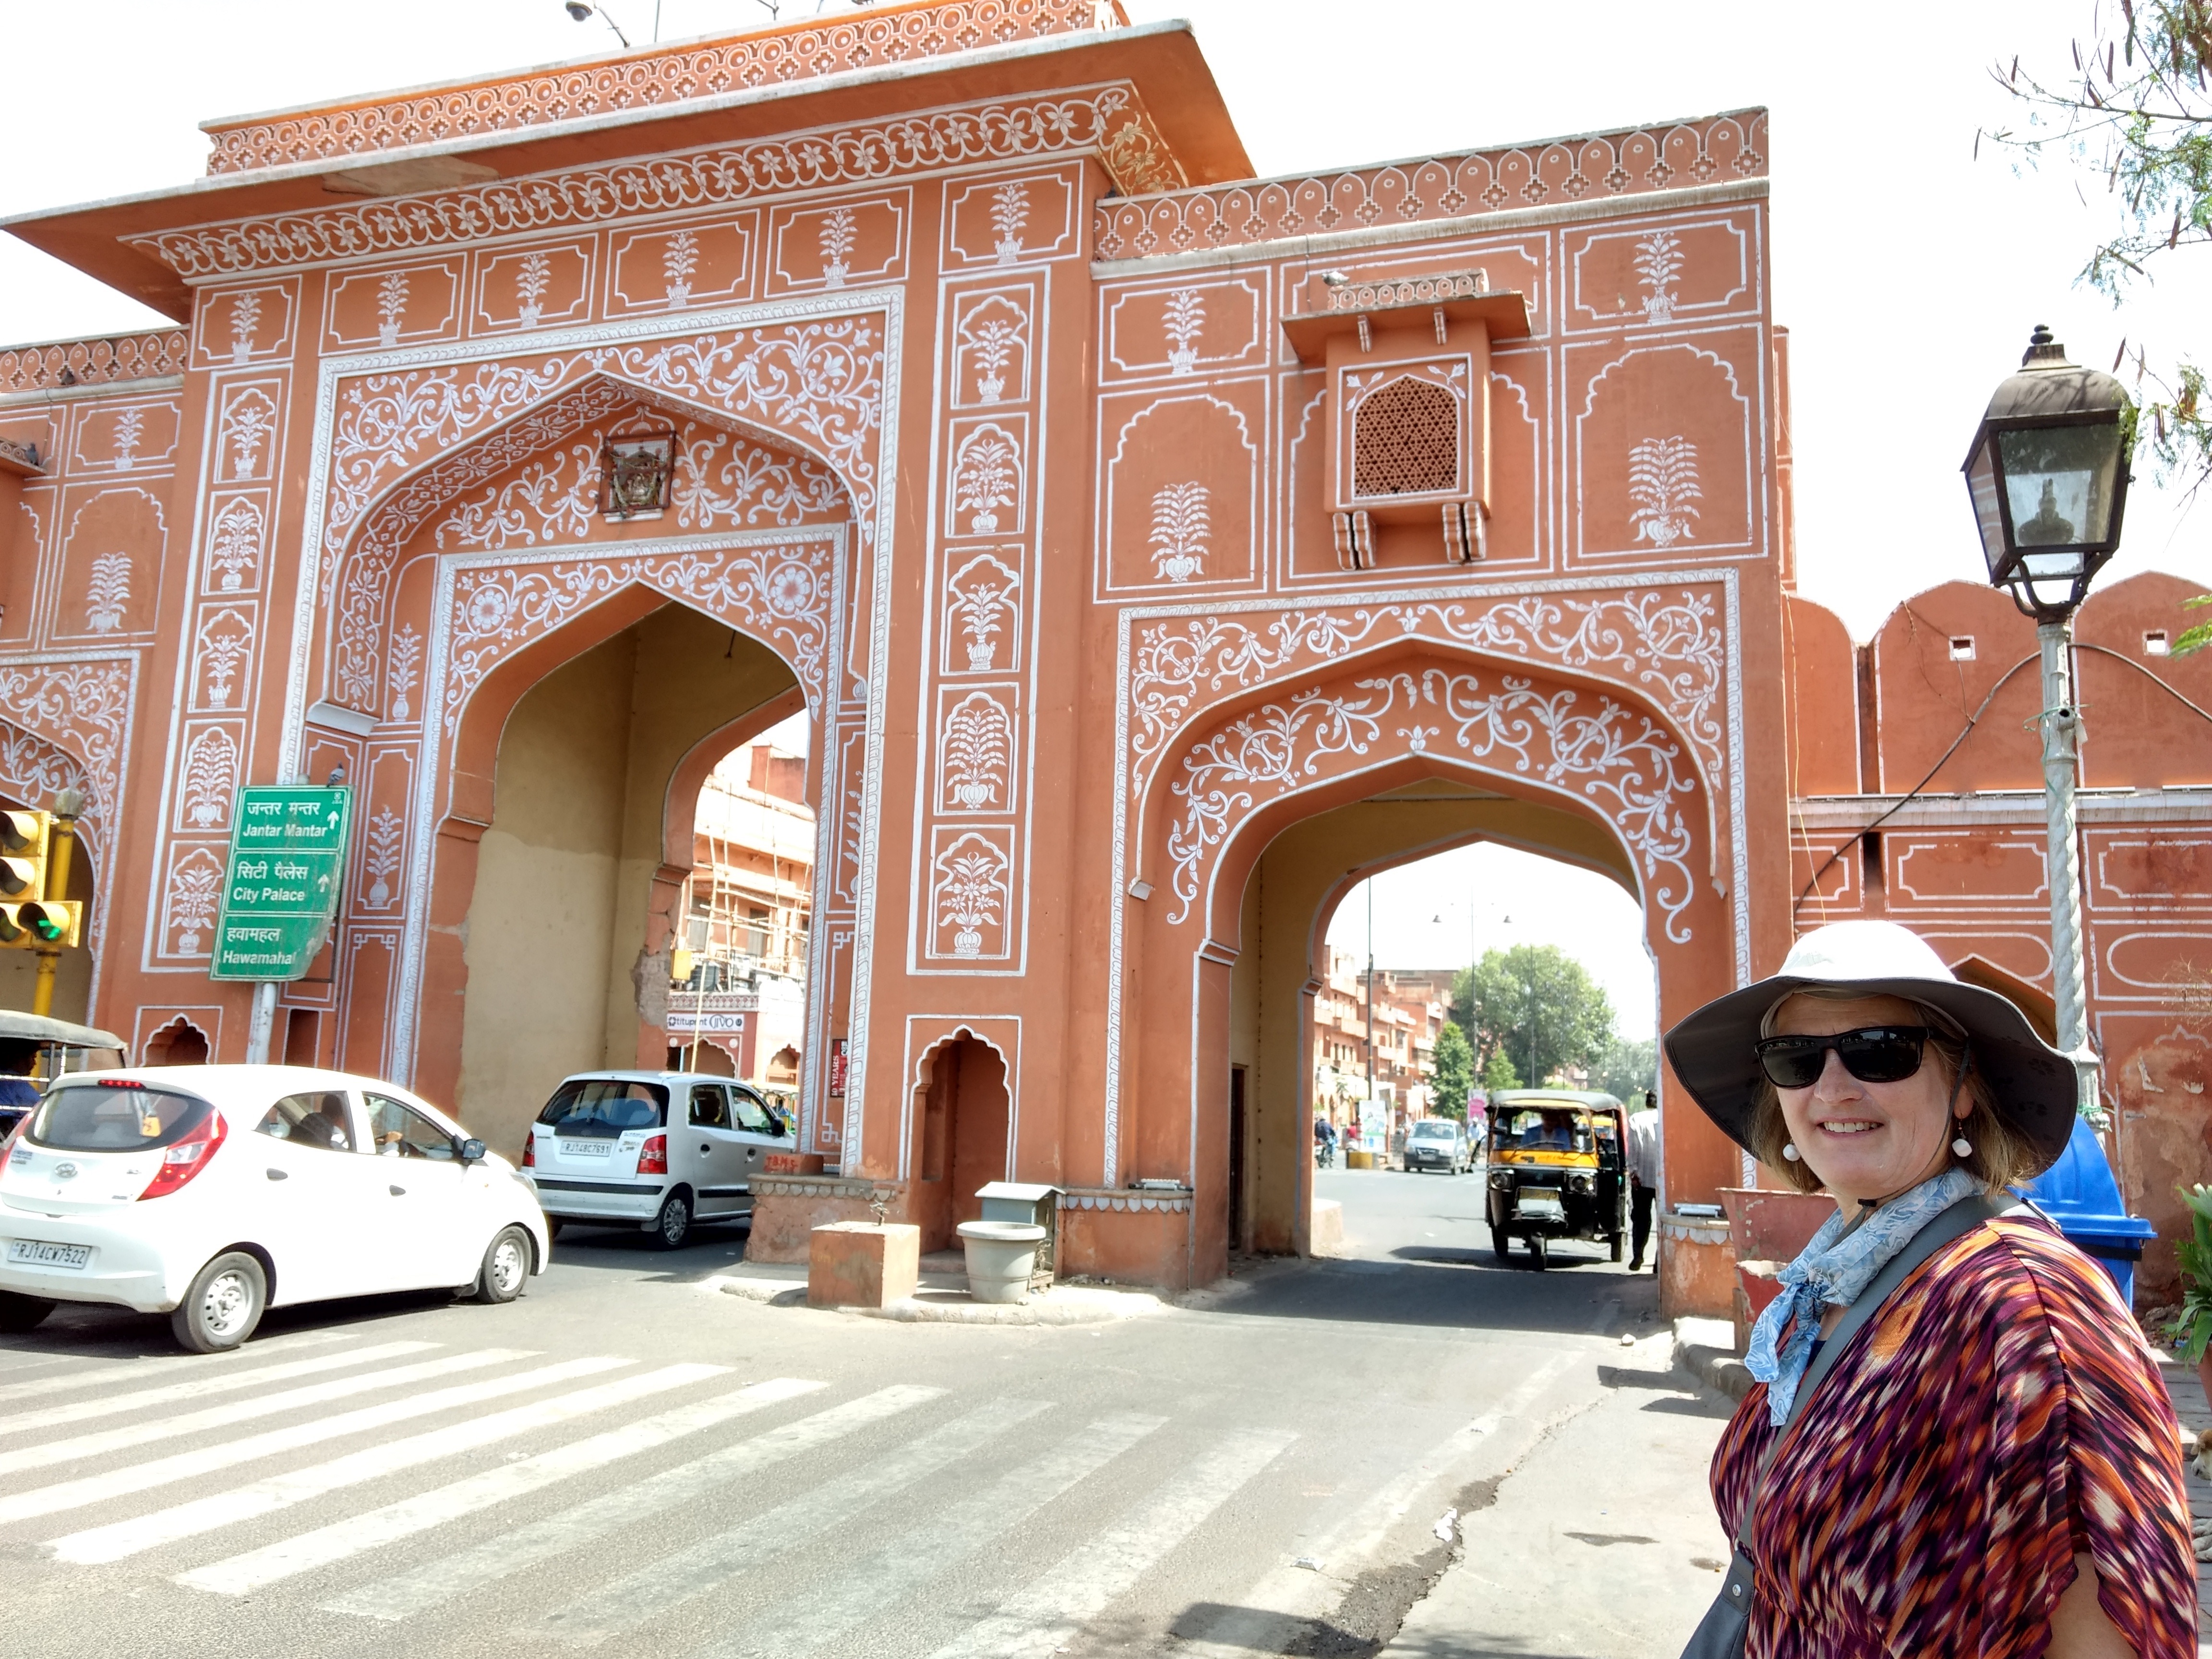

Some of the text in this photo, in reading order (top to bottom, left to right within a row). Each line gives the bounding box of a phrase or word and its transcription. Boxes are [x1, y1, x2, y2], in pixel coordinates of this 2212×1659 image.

[247, 802, 321, 816] जन्तर मन्तर
[243, 824, 327, 838] Jantar Mantar
[236, 861, 309, 880] सिटी पैलेस
[233, 887, 305, 903] City Palace
[227, 927, 281, 943] हवामहल
[223, 950, 297, 965] Hawamahal
[18, 1244, 85, 1264] RJ14CW7522
